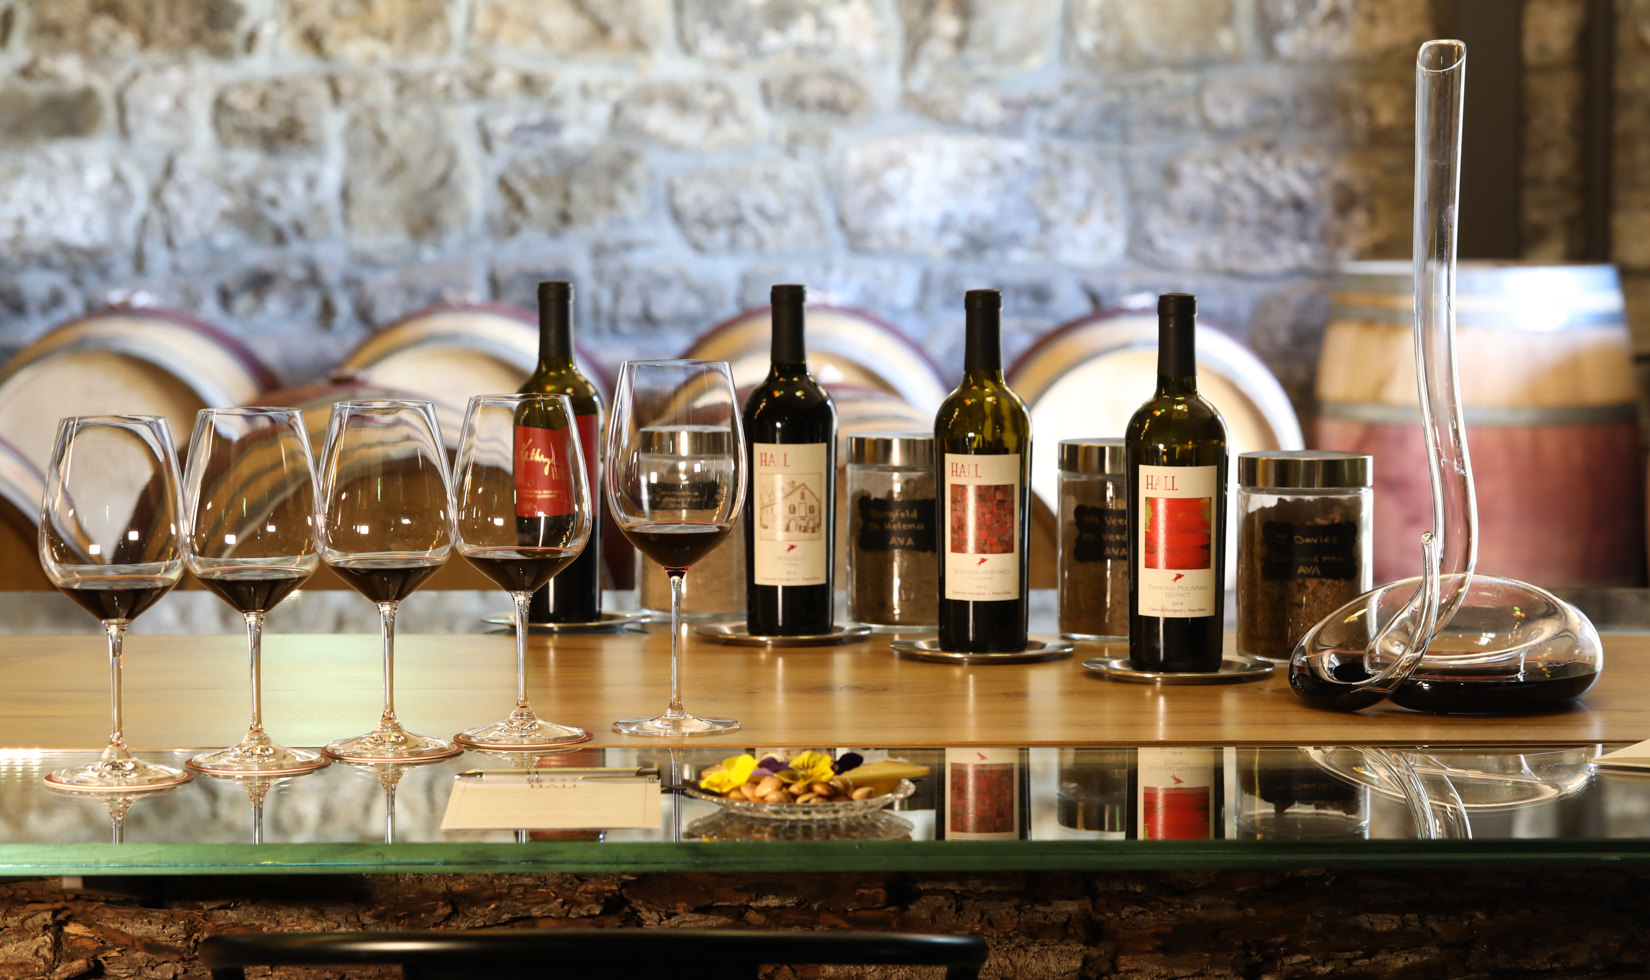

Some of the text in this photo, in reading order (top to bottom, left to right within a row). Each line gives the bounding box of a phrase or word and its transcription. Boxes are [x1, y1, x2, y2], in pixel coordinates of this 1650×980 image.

[759, 451, 791, 468] HALL
[951, 461, 982, 478] HALL
[1145, 474, 1179, 491] HALL
[889, 535, 915, 546] AVA
[1104, 546, 1128, 556] AVA
[1297, 564, 1321, 576] AVA
[1177, 584, 1208, 592] MOUNTAIN
